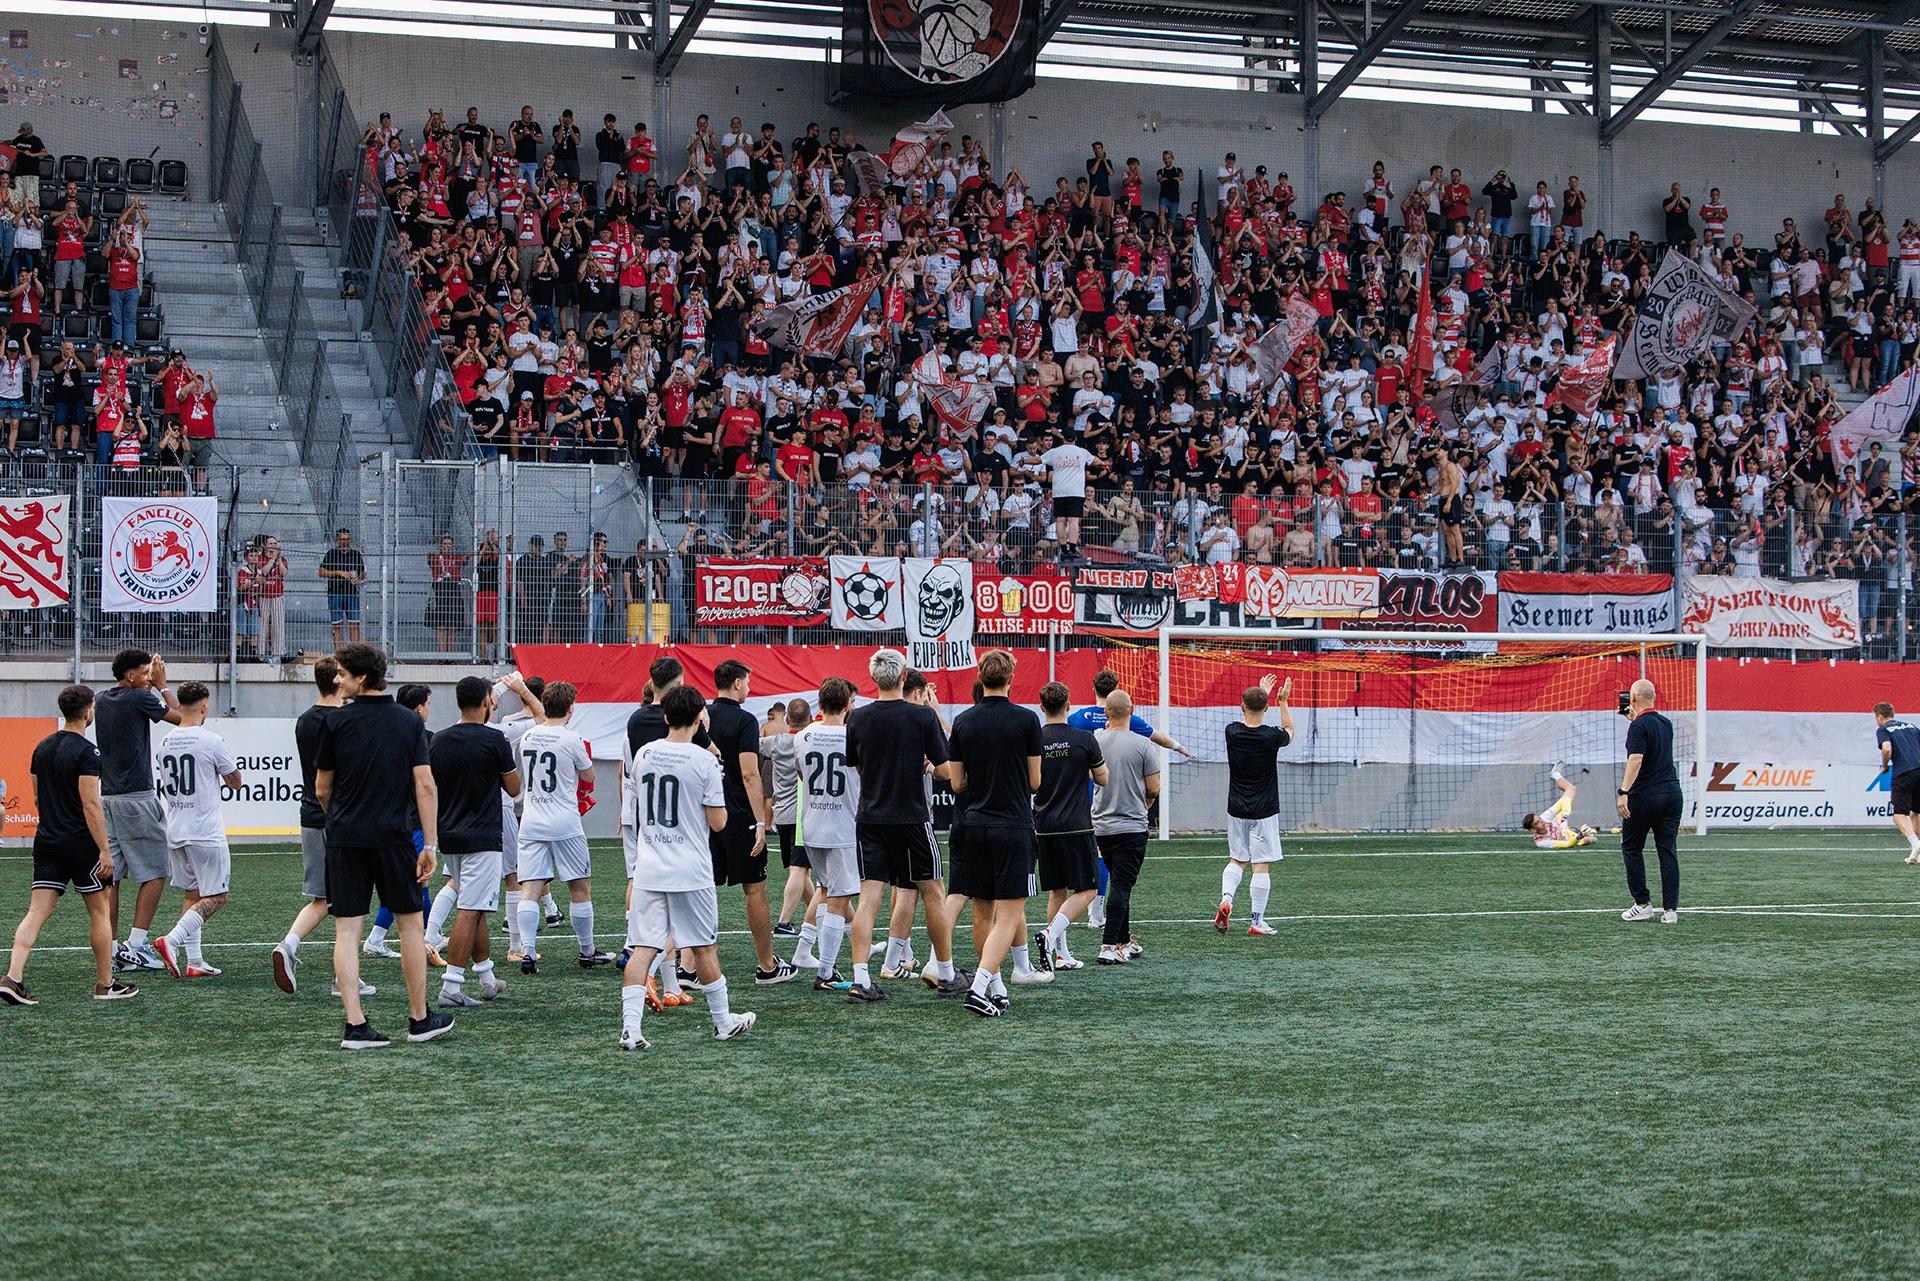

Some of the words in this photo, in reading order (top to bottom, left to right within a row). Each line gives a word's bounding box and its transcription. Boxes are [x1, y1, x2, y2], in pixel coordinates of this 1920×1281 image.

[1647, 297, 1665, 315] 20
[127, 508, 194, 529] FANCLUB
[119, 569, 202, 600] TRINKPAUSE
[142, 573, 151, 581] FC
[702, 575, 782, 603] 120er
[1076, 568, 1148, 588] JUGEND
[1152, 571, 1175, 589] 84
[1287, 579, 1374, 607] MAINZ
[1717, 589, 1816, 614] SEKTION
[978, 618, 1025, 634] ALTISE
[1508, 599, 1595, 627] Seemer
[1604, 601, 1669, 632] Jungs
[1728, 621, 1811, 638] ECKFAHNE
[913, 640, 973, 668] EUPHORIA
[1045, 750, 1070, 759] ACTIVE
[163, 753, 196, 797] 30
[523, 749, 557, 793] 73
[804, 750, 847, 798] 26
[641, 772, 680, 829] 10
